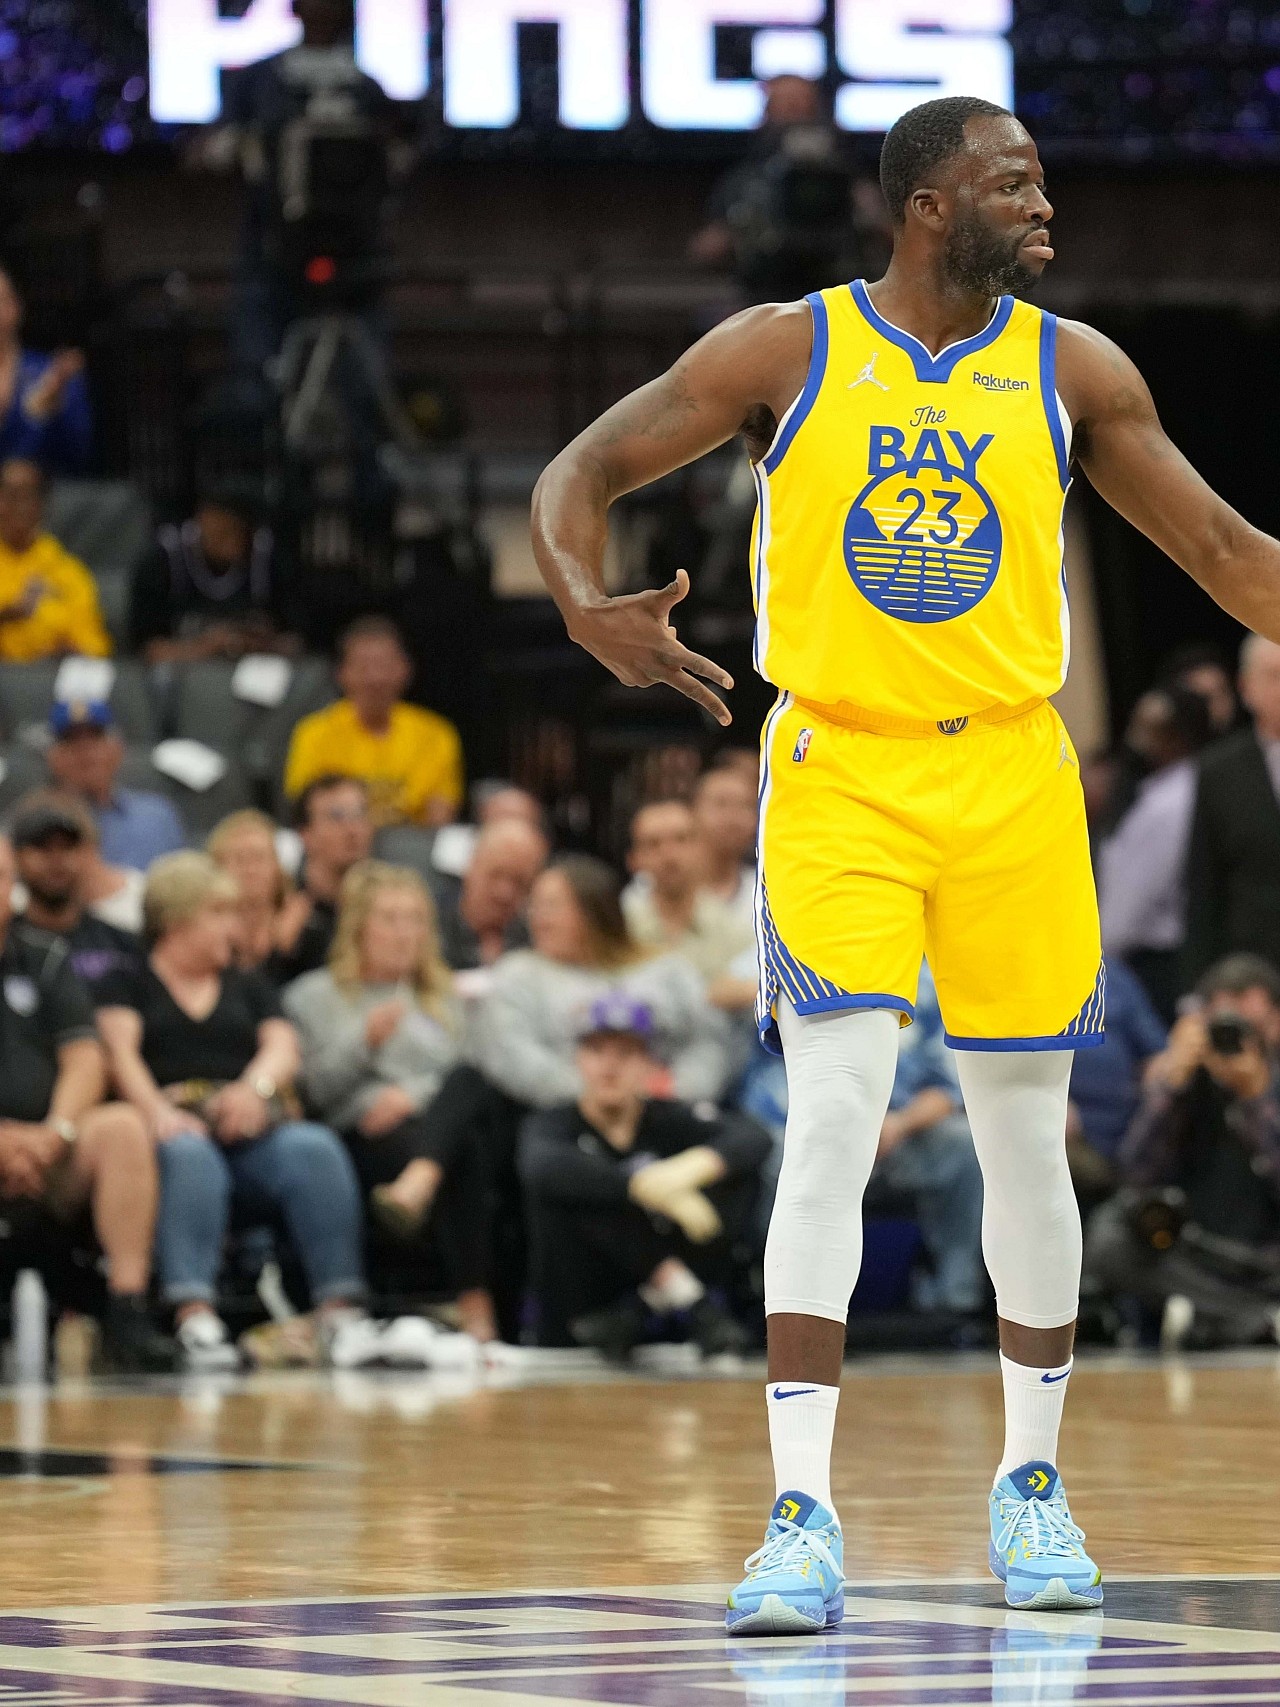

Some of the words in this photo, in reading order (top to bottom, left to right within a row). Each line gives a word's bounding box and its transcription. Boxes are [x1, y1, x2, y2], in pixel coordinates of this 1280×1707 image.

[973, 371, 1029, 392] Rakuten
[909, 405, 947, 427] The
[867, 425, 996, 482] BAY
[893, 487, 963, 545] 23
